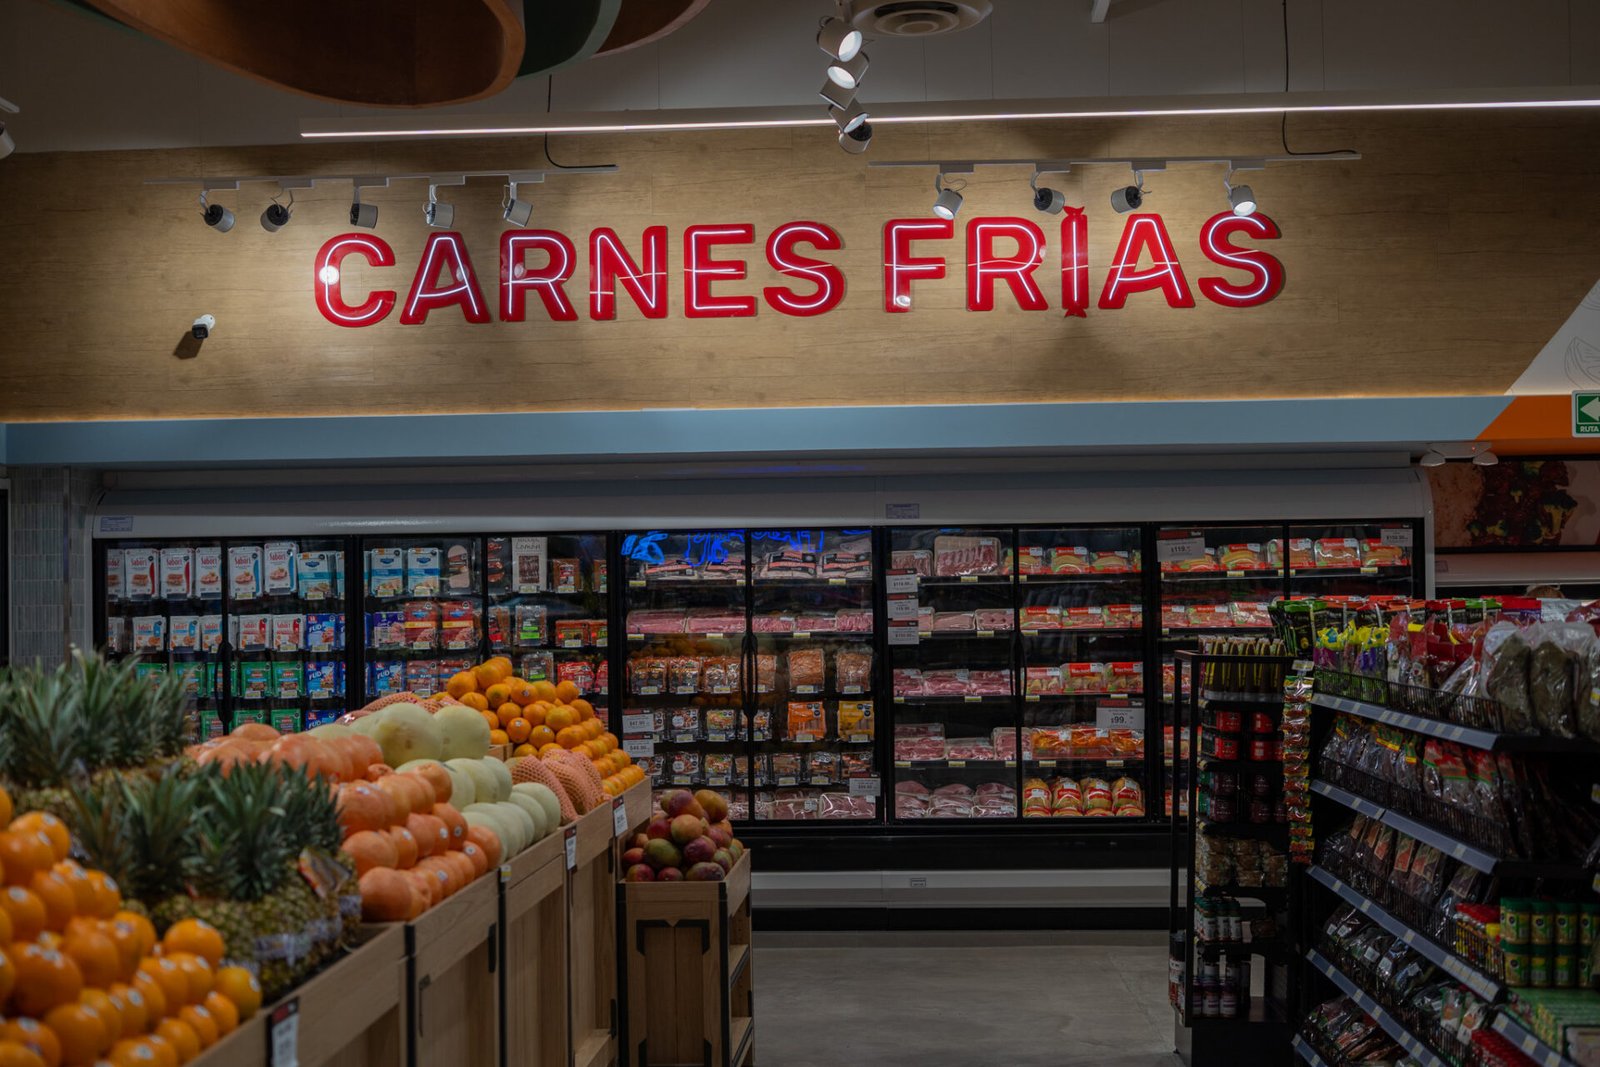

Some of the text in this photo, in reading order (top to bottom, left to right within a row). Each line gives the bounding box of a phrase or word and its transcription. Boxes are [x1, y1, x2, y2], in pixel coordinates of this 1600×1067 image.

[314, 221, 846, 328] CARNES
[1580, 425, 1600, 433] RUTA
[309, 670, 322, 680] FUD
